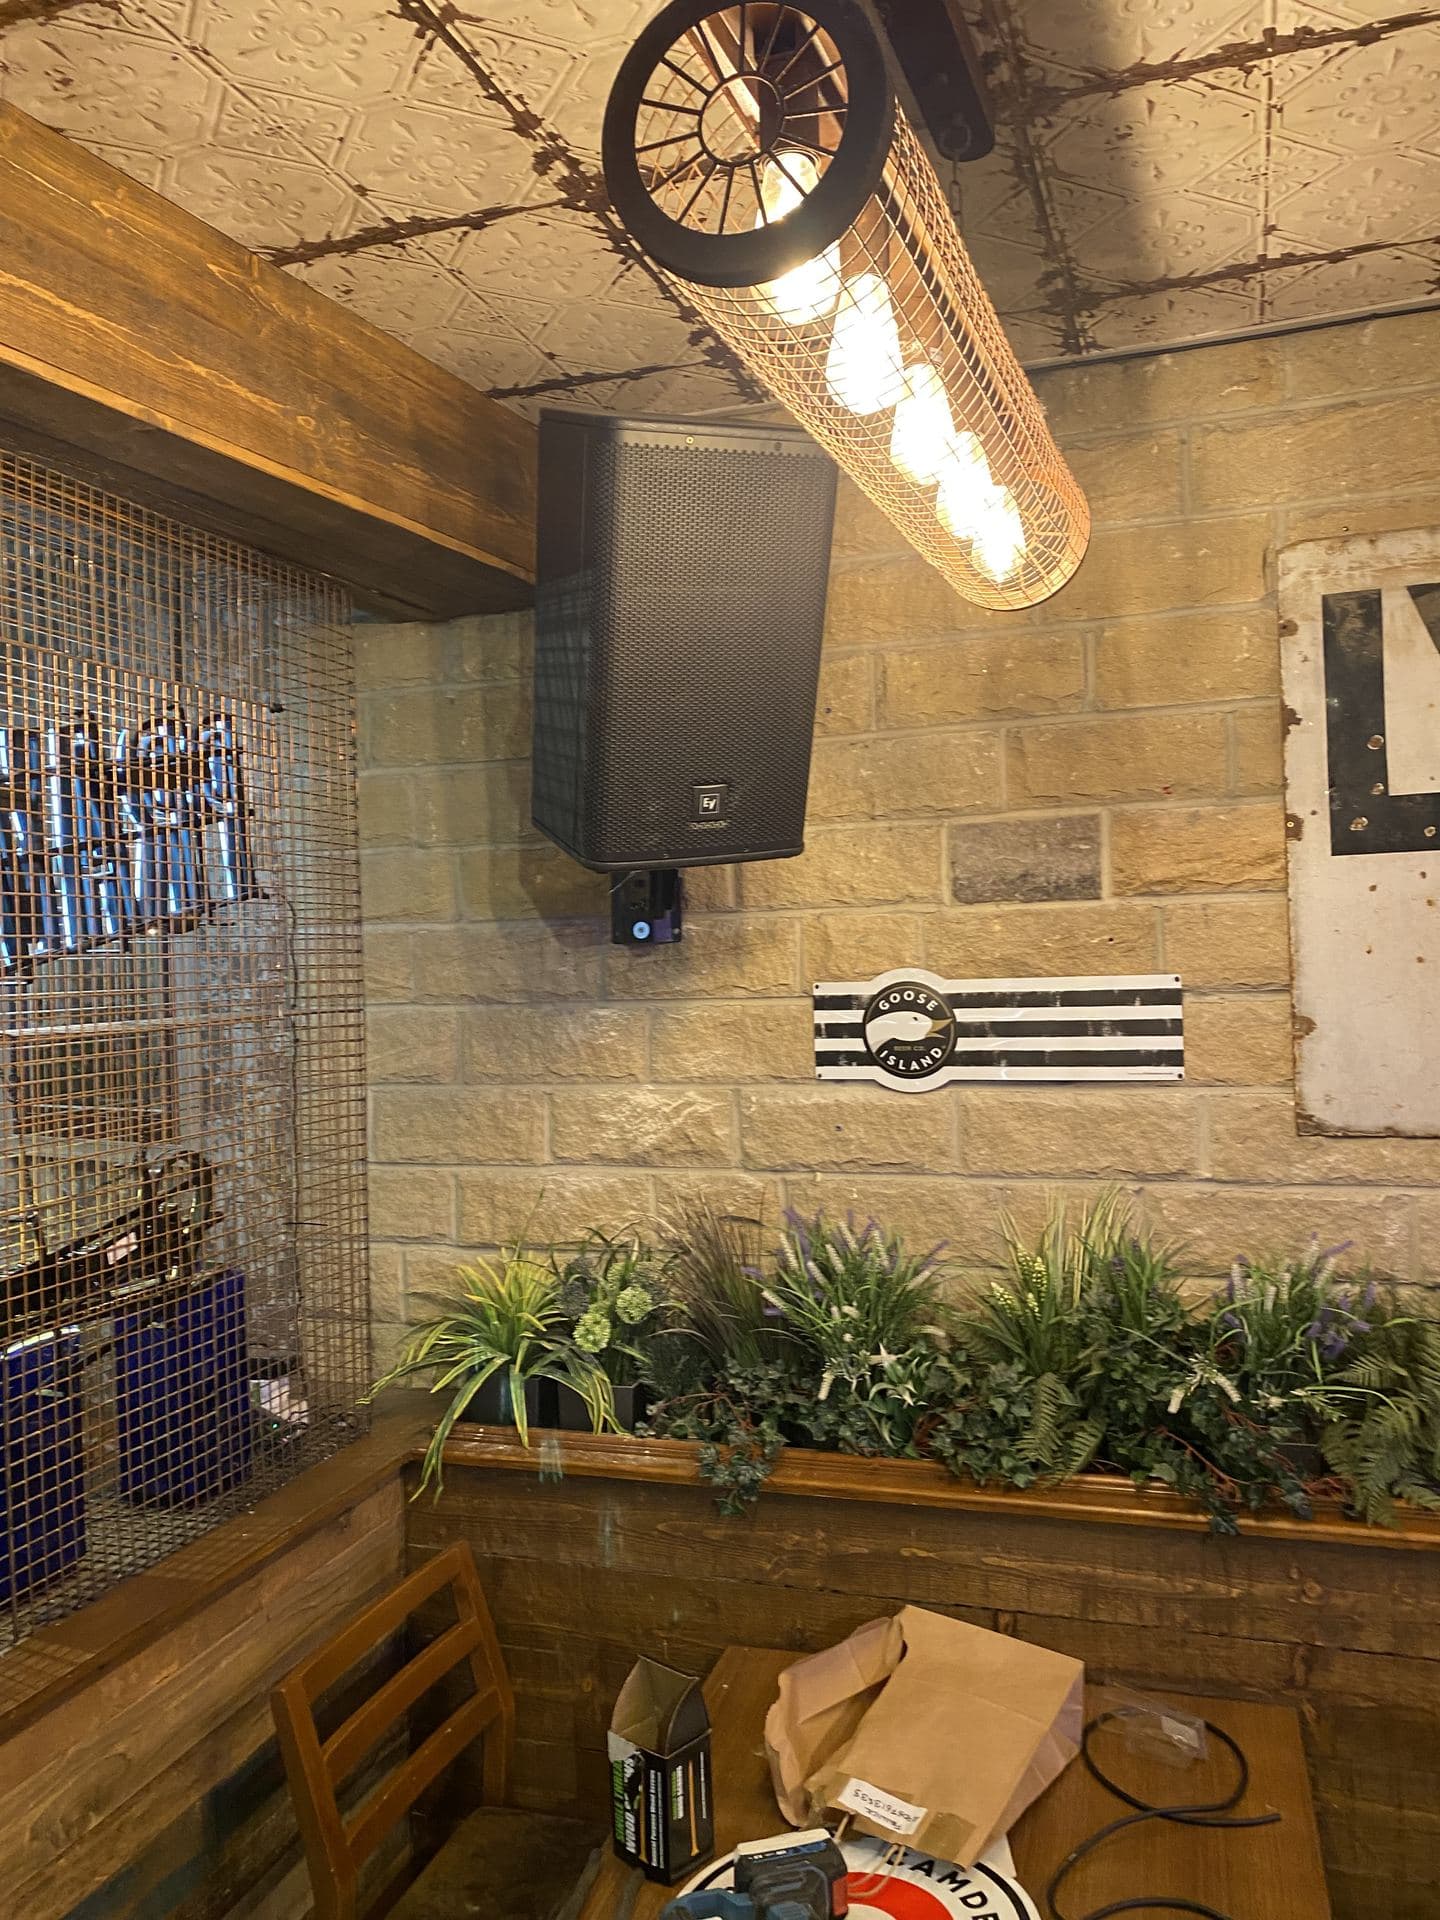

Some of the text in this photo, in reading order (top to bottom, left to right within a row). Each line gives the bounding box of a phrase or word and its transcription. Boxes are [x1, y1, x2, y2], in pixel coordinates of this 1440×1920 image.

[879, 990, 938, 1011] GOOSE
[880, 1047, 942, 1071] ISLAND
[624, 1811, 637, 1854] WOOD
